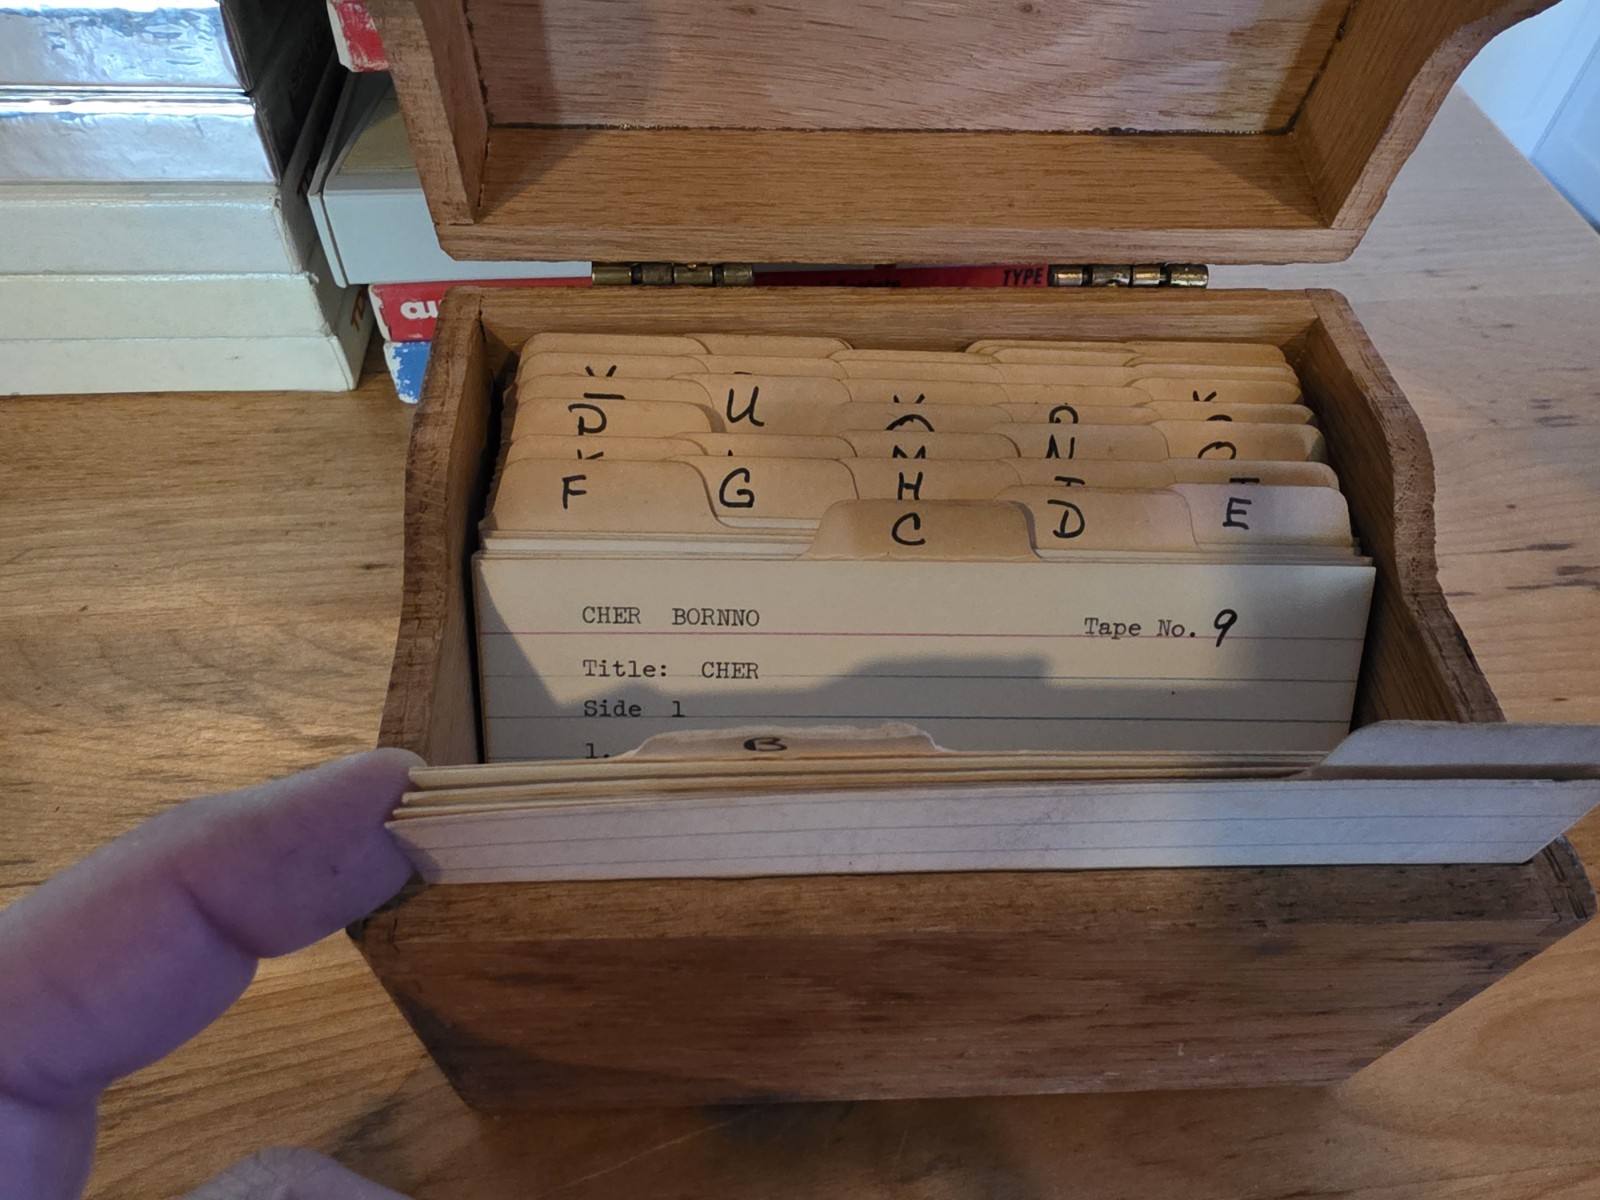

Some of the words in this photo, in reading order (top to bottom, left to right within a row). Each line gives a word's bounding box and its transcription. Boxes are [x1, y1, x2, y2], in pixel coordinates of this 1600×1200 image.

[1003, 268, 1043, 286] TYPE
[401, 301, 439, 319] au
[725, 385, 765, 428] U
[562, 475, 587, 509] F
[719, 468, 754, 508] G
[898, 472, 923, 501] H
[1047, 499, 1085, 538] D
[1223, 497, 1252, 530] E
[892, 513, 925, 545] C
[583, 606, 640, 624] CHER
[672, 608, 759, 626] BORNNO
[1085, 618, 1141, 639] Tape
[1157, 620, 1195, 638] No.
[1214, 609, 1237, 647] 9
[583, 660, 666, 677] Title:
[702, 662, 758, 679] CHER
[584, 700, 641, 717] Side
[672, 701, 685, 717] 1
[744, 737, 787, 751] B
